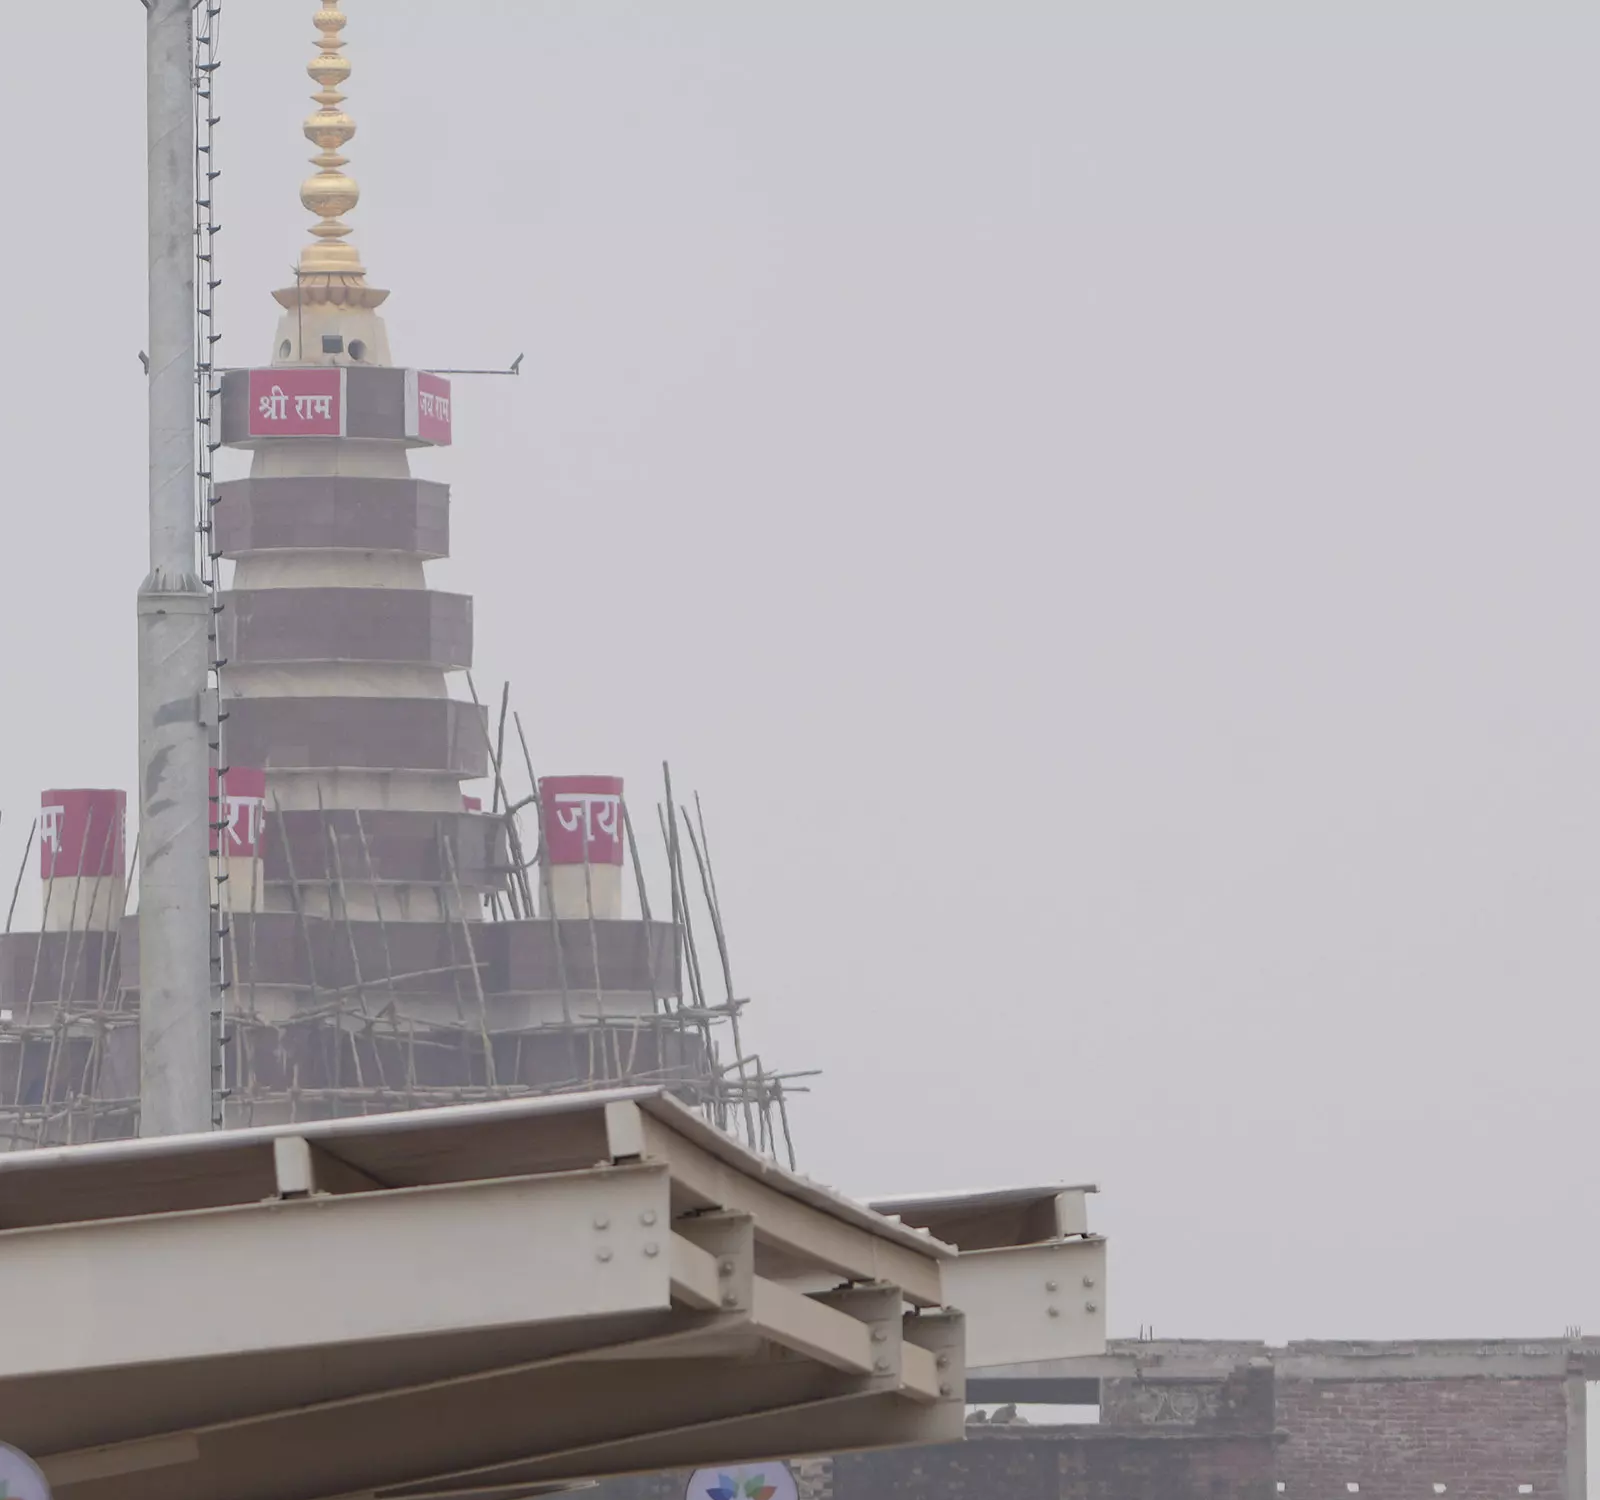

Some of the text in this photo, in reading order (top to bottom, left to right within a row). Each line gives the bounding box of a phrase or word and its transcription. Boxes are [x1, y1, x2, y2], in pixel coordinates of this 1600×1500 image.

[259, 385, 333, 420] श्री राम
[555, 793, 621, 844] जय
